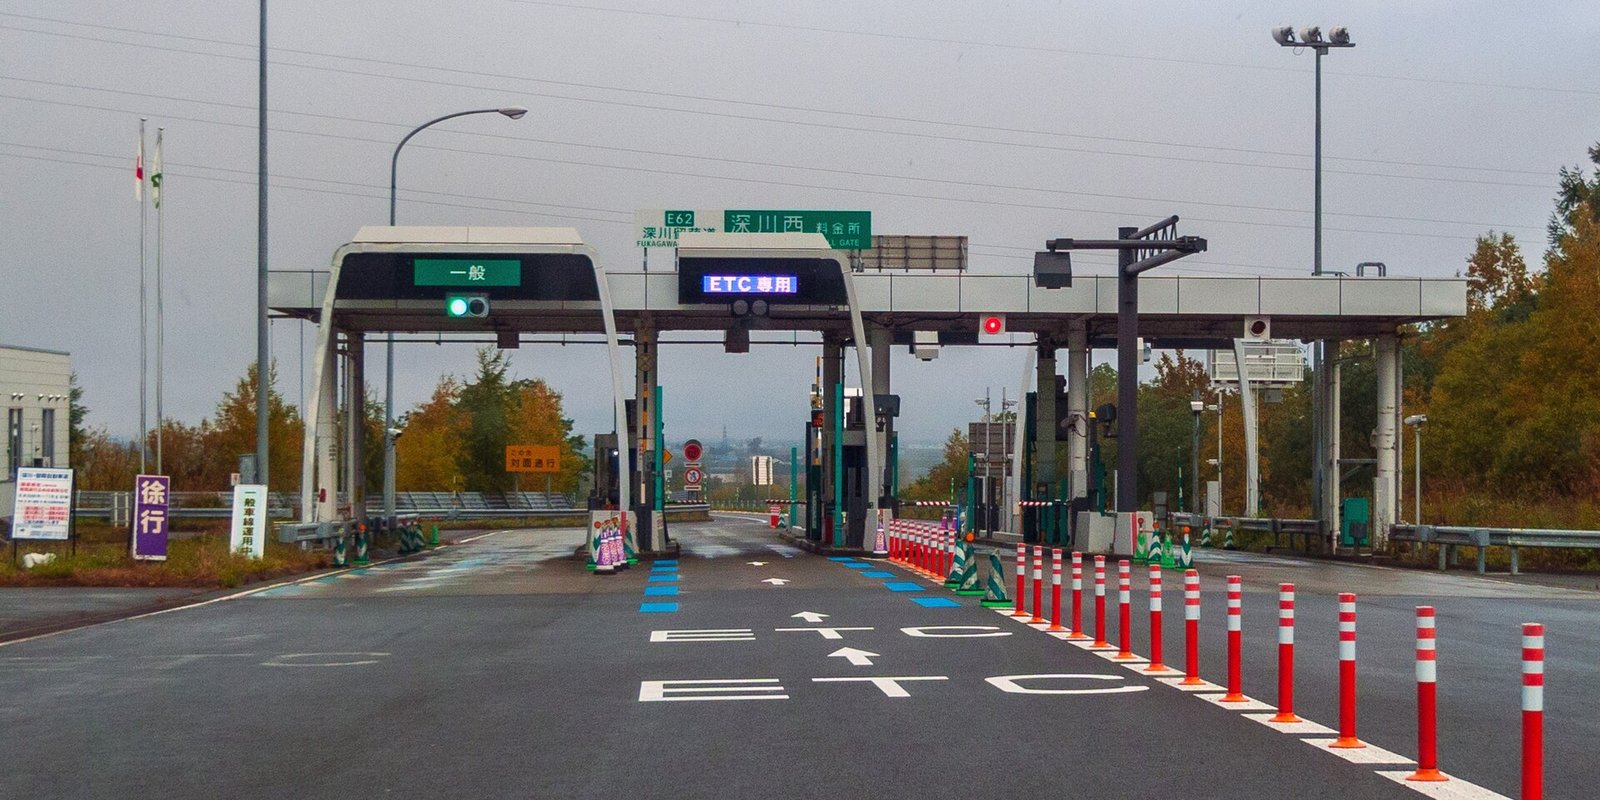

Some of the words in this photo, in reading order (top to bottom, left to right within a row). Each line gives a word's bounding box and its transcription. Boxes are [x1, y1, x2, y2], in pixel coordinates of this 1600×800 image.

[667, 213, 693, 225] E62
[731, 214, 804, 233] 深川西
[816, 222, 860, 235] 料金所
[839, 239, 860, 248] GATE
[450, 265, 486, 280] 一般
[710, 276, 751, 292] ETC
[756, 276, 791, 293] 専用
[511, 457, 556, 468] 対面通行
[140, 480, 166, 534] 徐行
[650, 625, 1013, 643] ETC
[638, 673, 1151, 702] ETC
